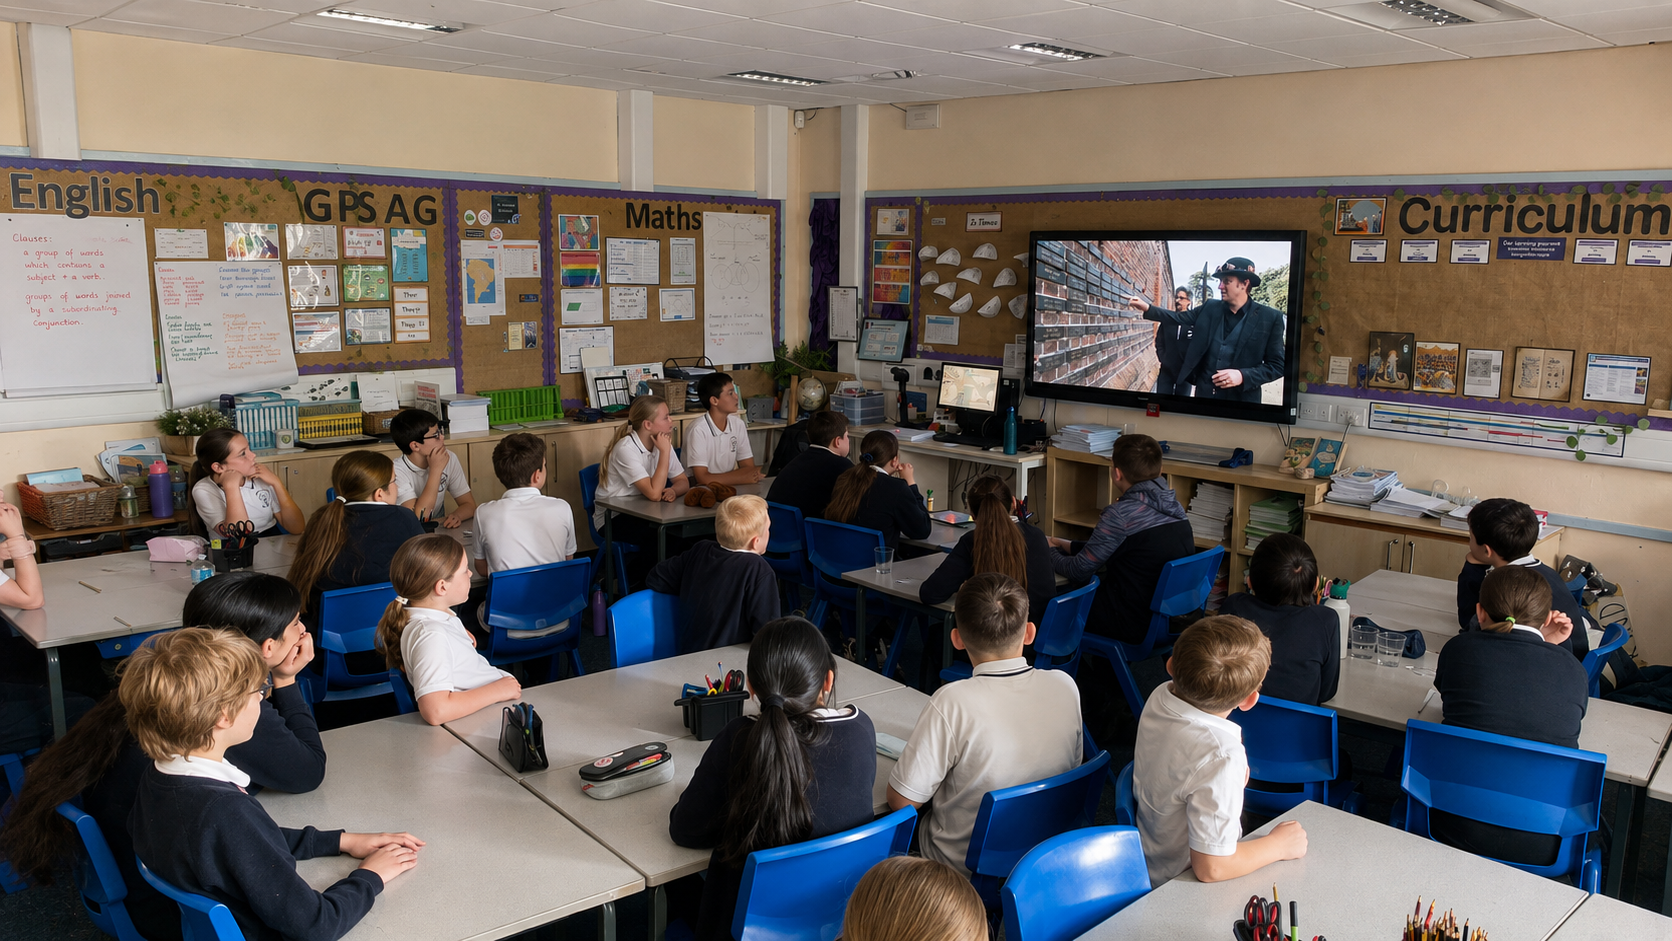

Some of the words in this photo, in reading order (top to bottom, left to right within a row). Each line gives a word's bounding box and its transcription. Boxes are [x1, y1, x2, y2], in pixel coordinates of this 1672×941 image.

[10, 172, 160, 219] English
[625, 202, 702, 231] Maths
[1399, 193, 1671, 235] Curriculum
[12, 233, 53, 243] Clauses:
[35, 249, 59, 260] group
[65, 248, 74, 260] of
[80, 248, 104, 257] words
[25, 261, 49, 269] which
[26, 273, 56, 284] subject
[25, 293, 52, 305] groups
[60, 291, 68, 302] of
[75, 291, 99, 299] words
[30, 306, 41, 317] by
